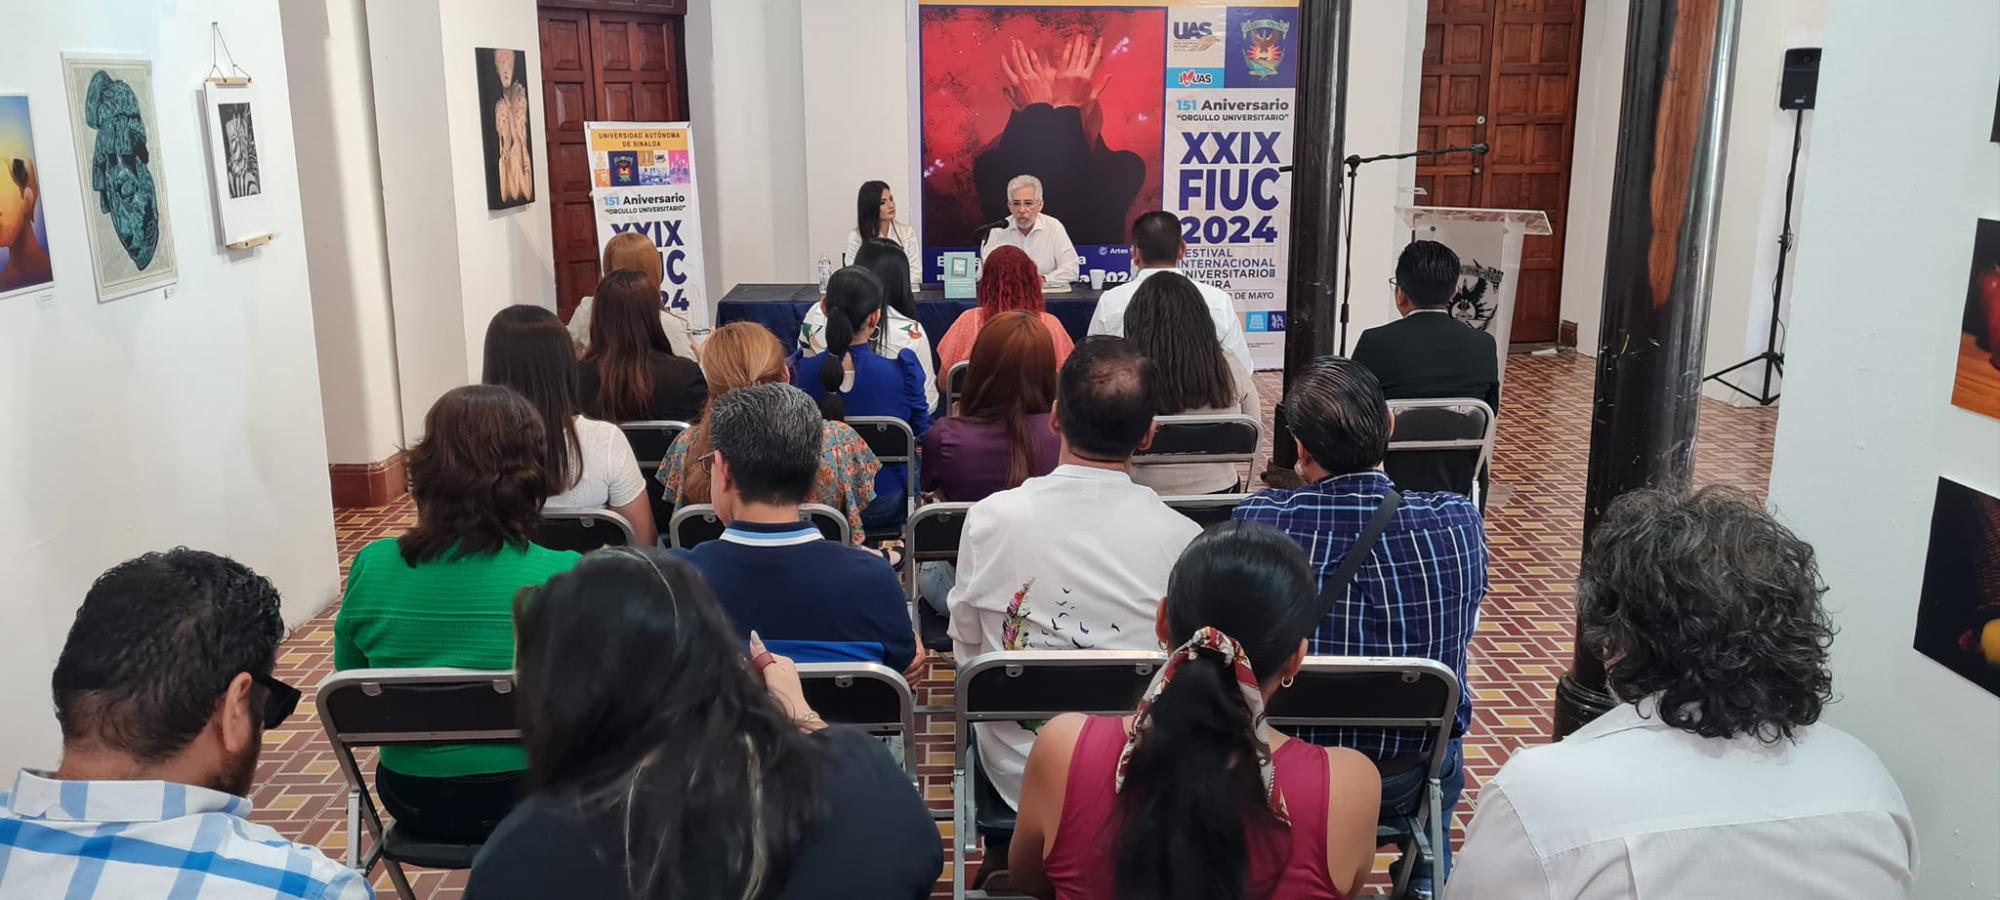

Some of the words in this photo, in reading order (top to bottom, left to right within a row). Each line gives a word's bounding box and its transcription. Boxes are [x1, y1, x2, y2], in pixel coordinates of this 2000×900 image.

[1173, 21, 1212, 39] UAS
[1175, 99, 1197, 110] 151
[1201, 98, 1289, 111] Aniversario
[1180, 131, 1281, 164] XXIX
[1178, 167, 1281, 211] FIUC
[604, 196, 619, 206] 151
[623, 192, 685, 205] Aniversario
[1180, 215, 1278, 244] 2024
[1184, 248, 1233, 258] ESTIVAL
[1182, 269, 1269, 279] NIVERSITARIO
[1234, 292, 1246, 300] DE
[1248, 291, 1275, 300] MAYO
